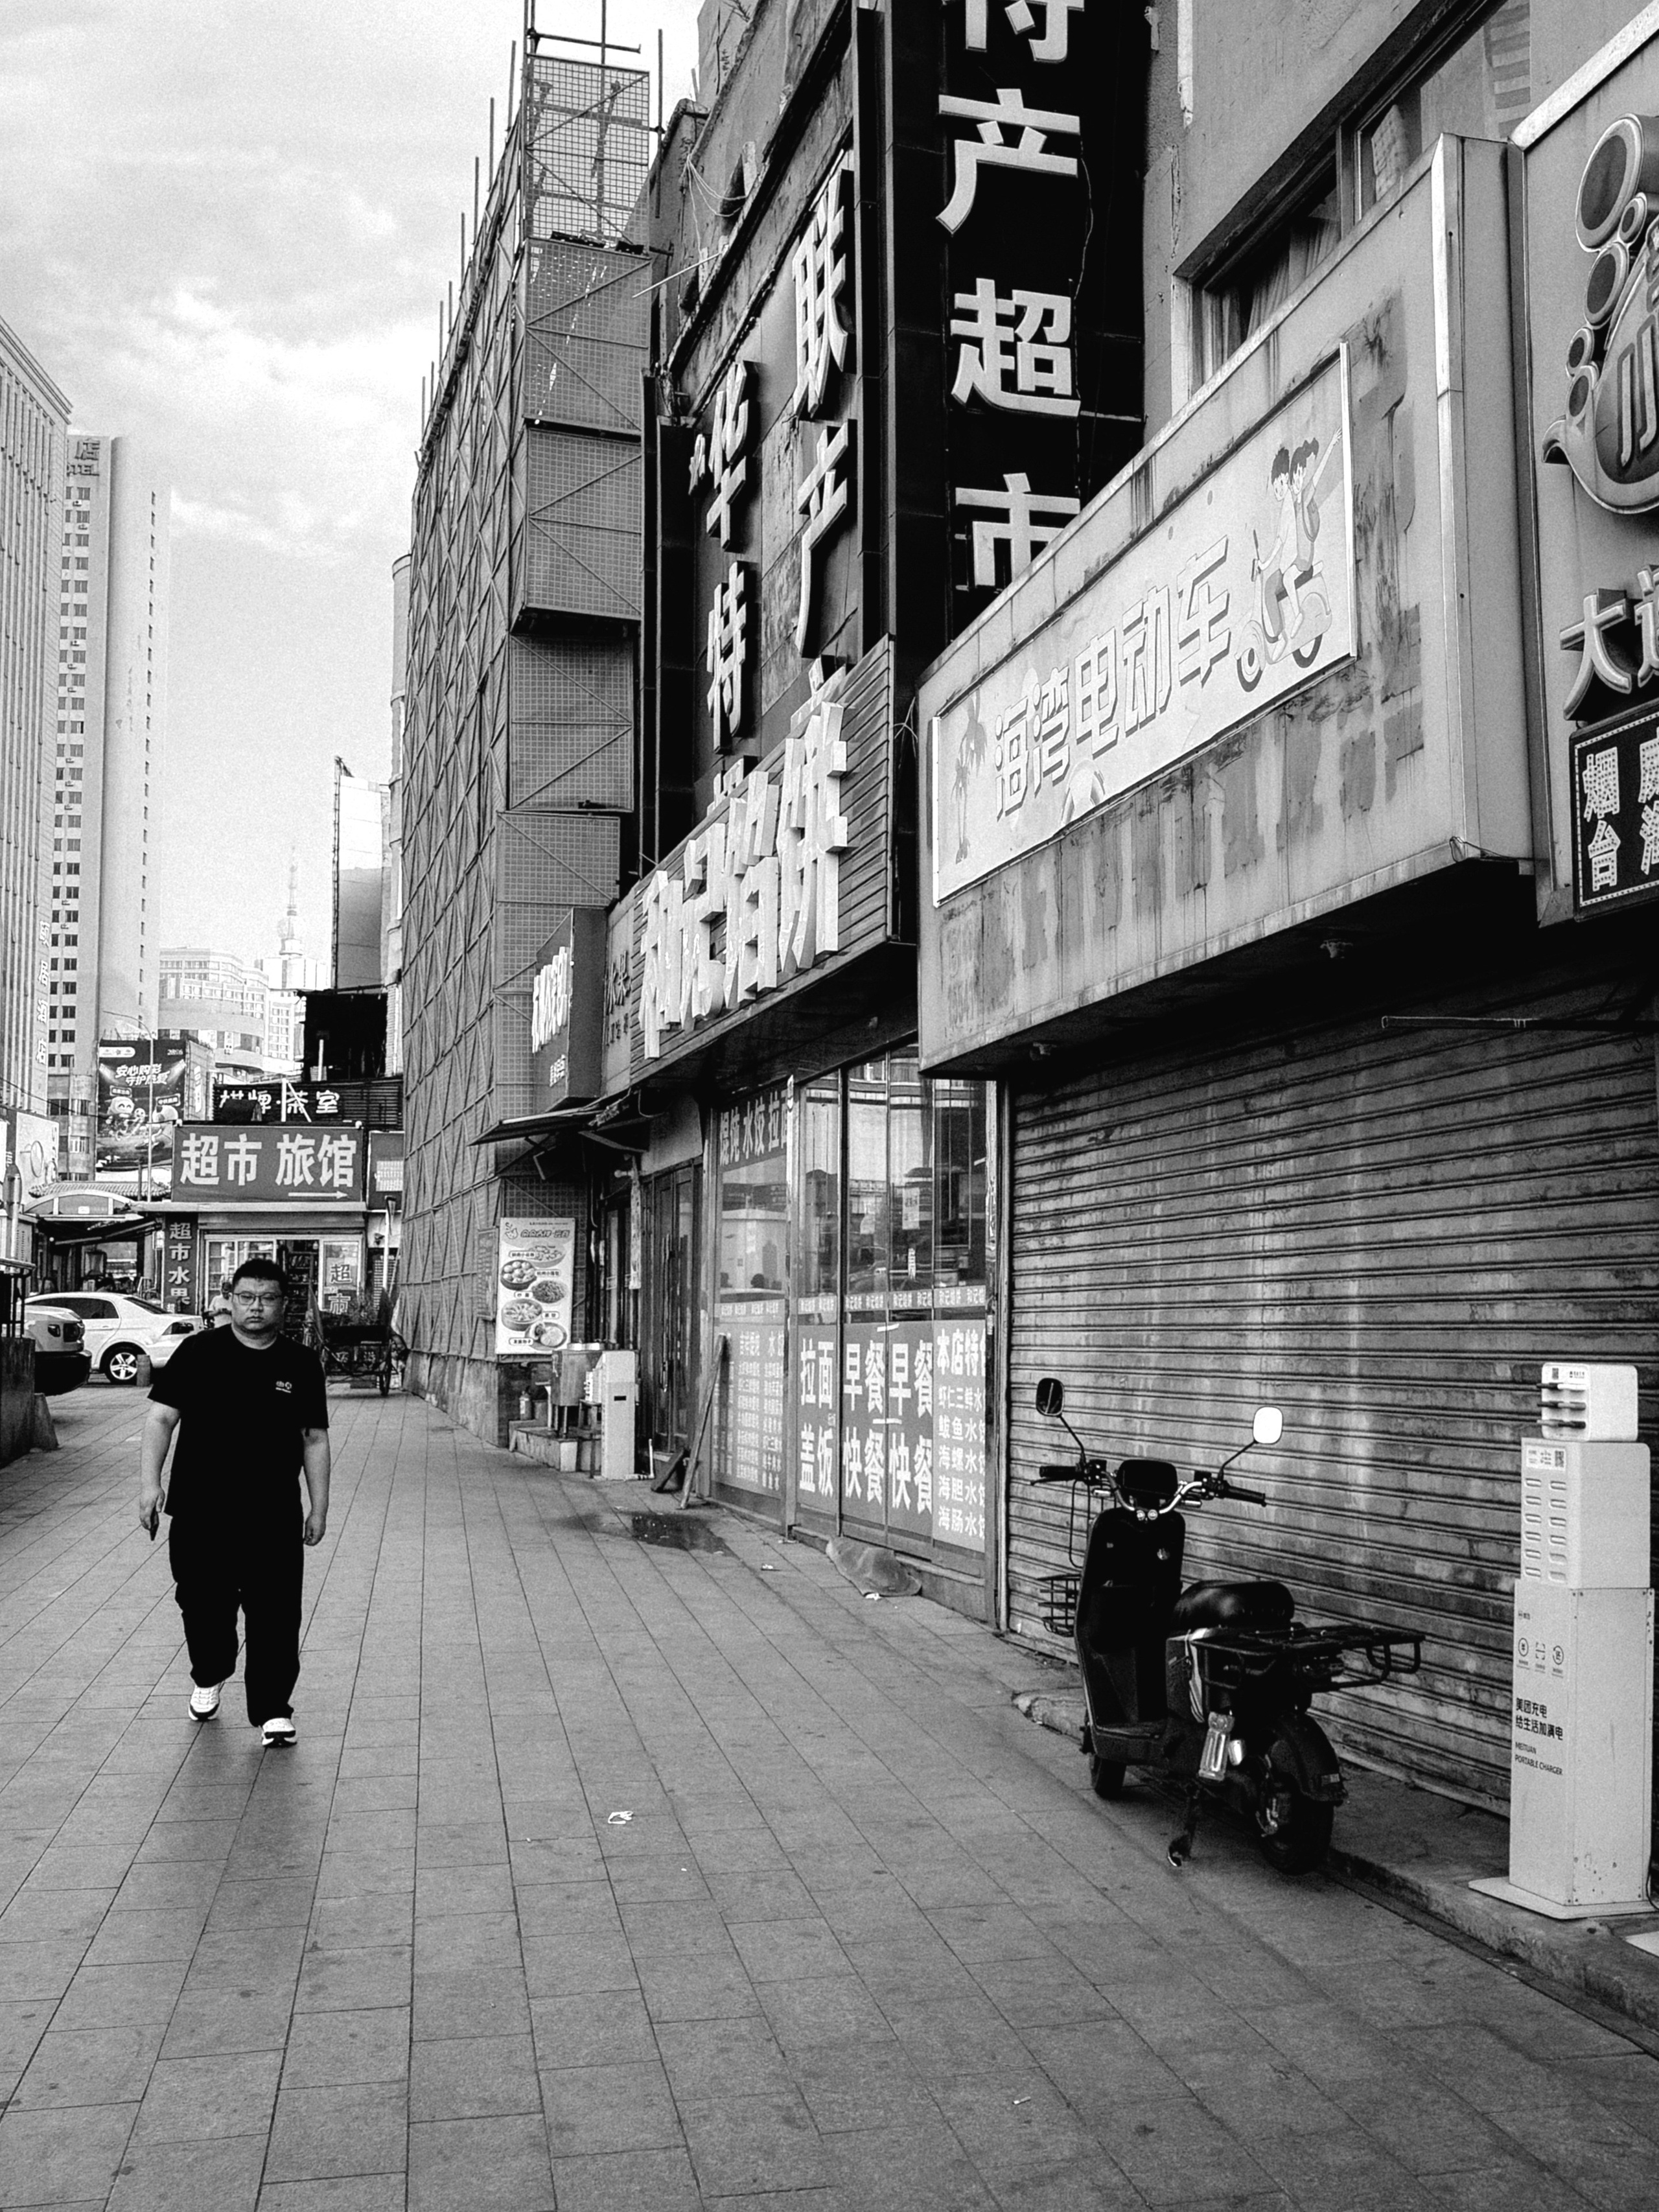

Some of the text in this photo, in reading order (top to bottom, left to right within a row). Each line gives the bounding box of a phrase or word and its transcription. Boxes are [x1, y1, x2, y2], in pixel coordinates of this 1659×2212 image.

[995, 535, 1231, 822] 海湾电动车
[180, 1134, 262, 1186] 超市
[275, 1133, 356, 1187] 旅馆
[742, 1096, 765, 1159] 水饺
[168, 1222, 192, 1312] 超市水果
[328, 1264, 353, 1315] 超市
[800, 1338, 835, 1410] 拉面
[844, 1340, 885, 1414] 早餐
[889, 1339, 933, 1418] 早餐
[938, 1385, 985, 1412] 虾仁三鲜水
[800, 1422, 833, 1498] 盖饭
[842, 1426, 885, 1506] 快餐
[889, 1432, 933, 1515] 快餐
[1515, 1714, 1563, 1741] 给生活加满电
[1516, 1697, 1547, 1718] 美团充电
